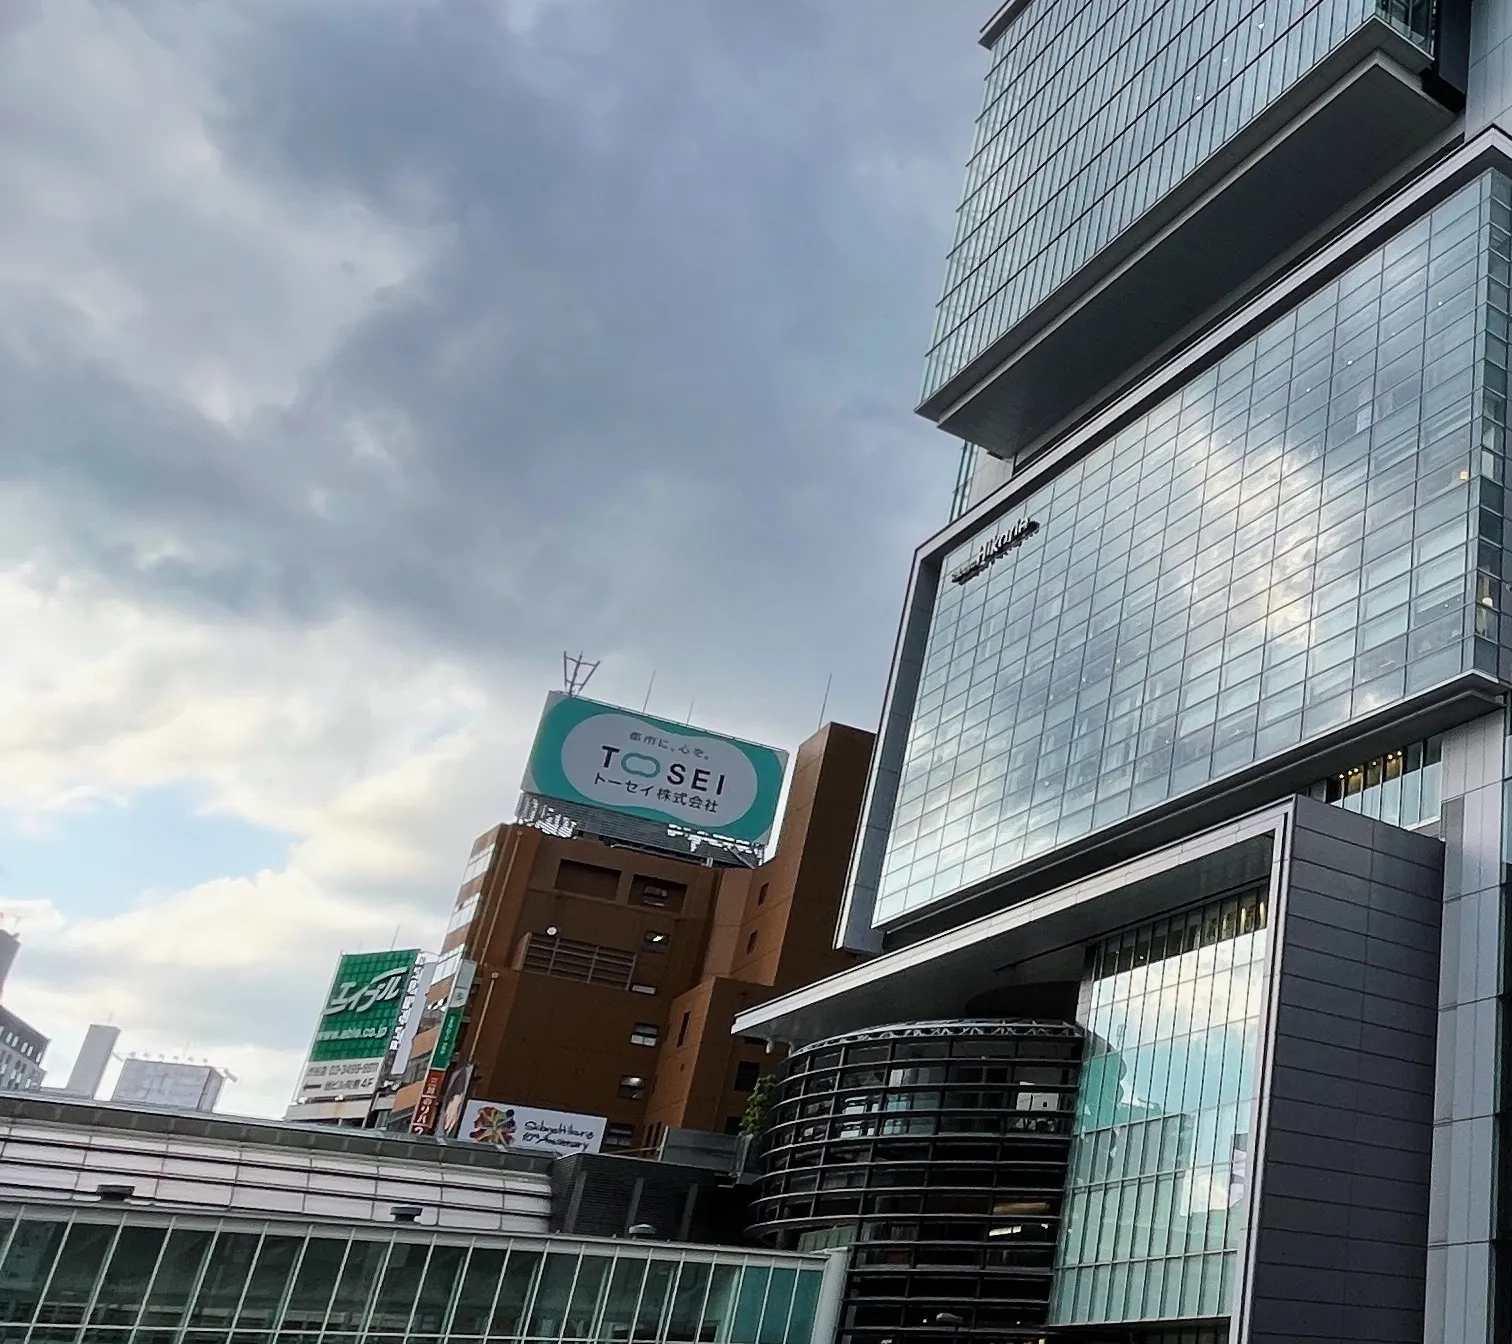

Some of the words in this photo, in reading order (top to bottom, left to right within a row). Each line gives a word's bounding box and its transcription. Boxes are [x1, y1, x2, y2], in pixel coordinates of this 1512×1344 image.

[594, 772, 718, 813] トーセイ株式会社
[601, 745, 725, 796] TOSEI
